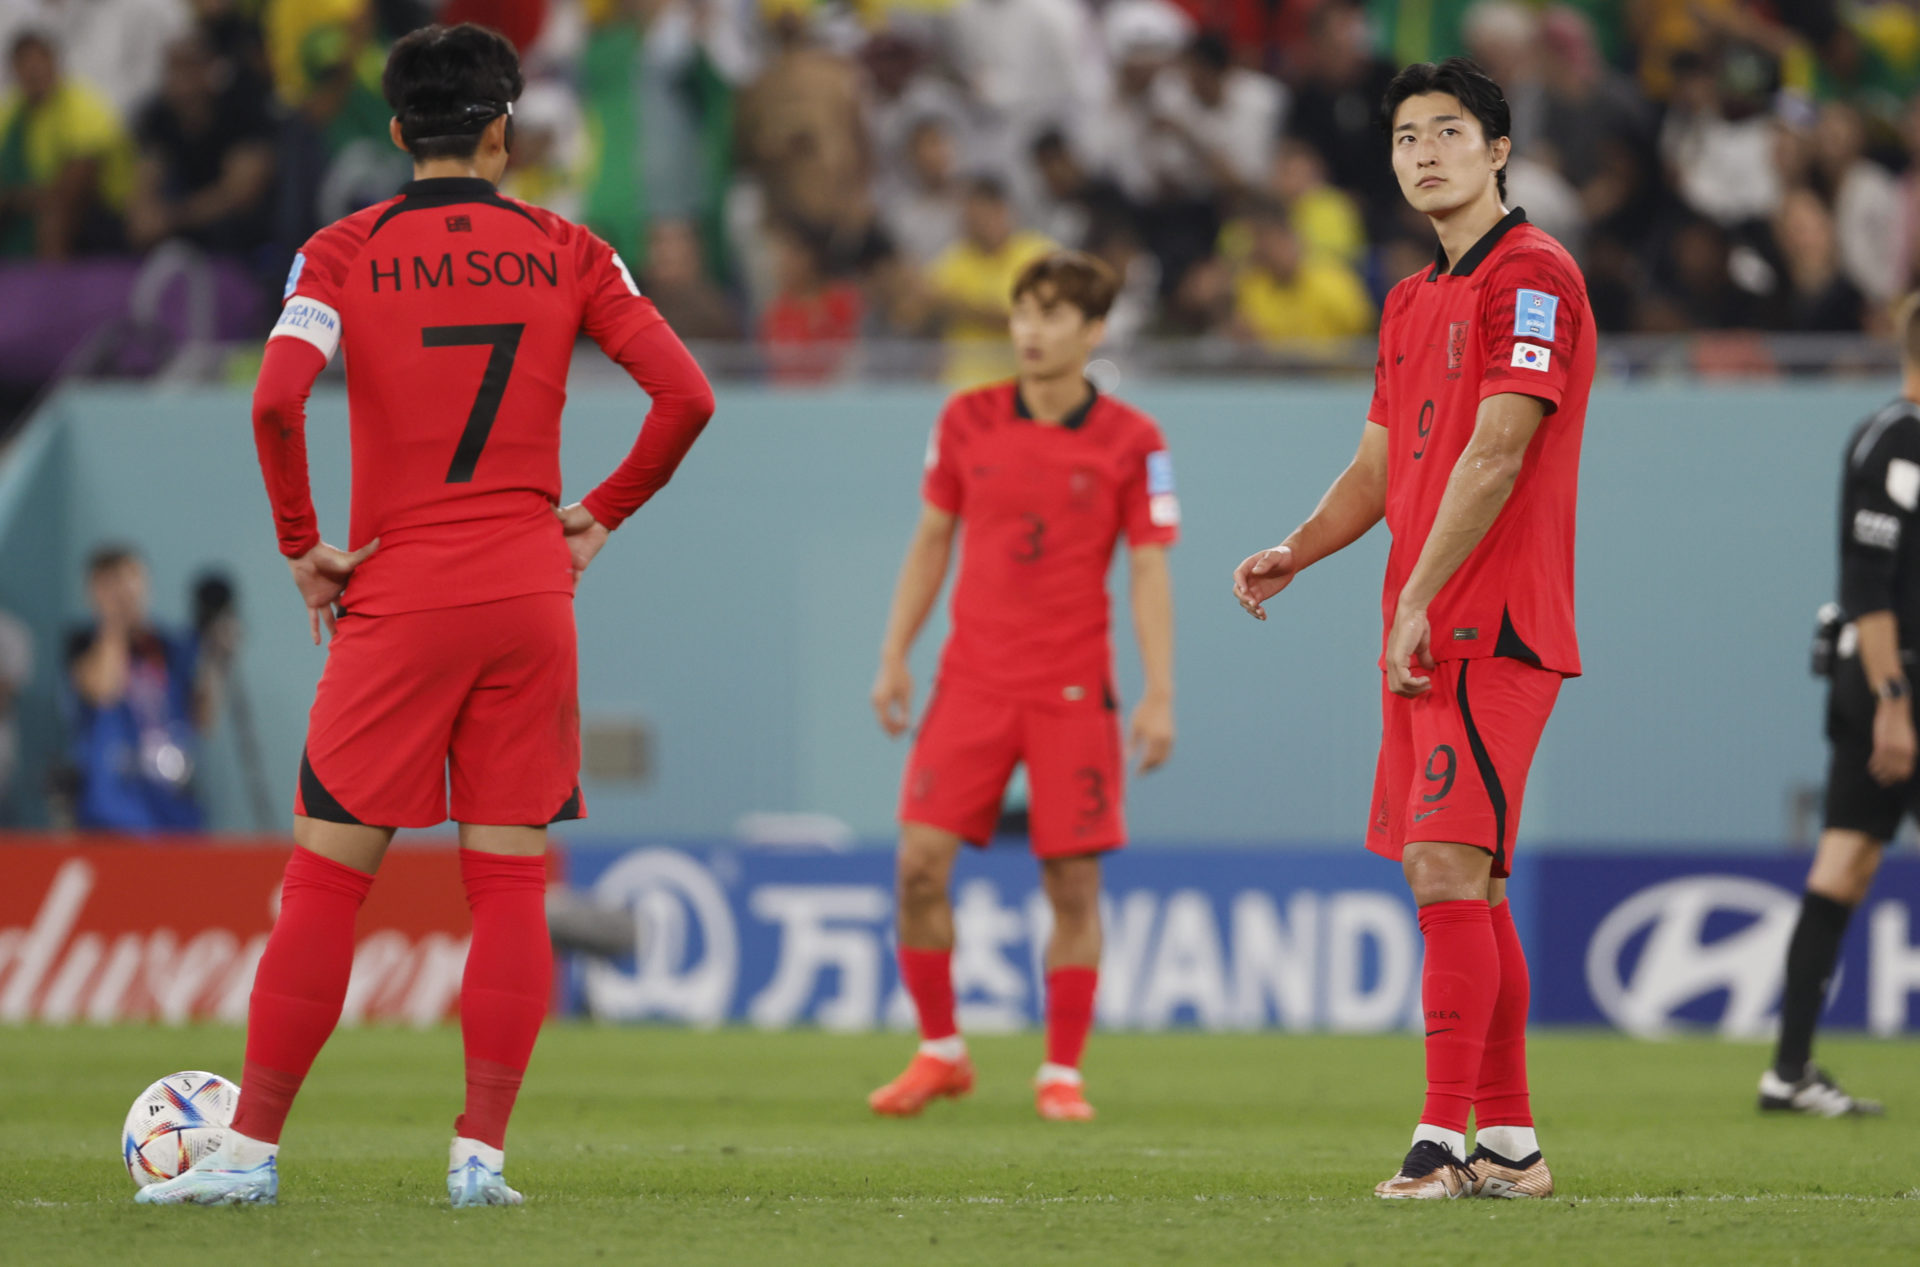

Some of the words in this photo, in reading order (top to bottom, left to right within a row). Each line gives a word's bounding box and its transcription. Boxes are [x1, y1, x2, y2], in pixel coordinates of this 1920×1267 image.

[466, 250, 558, 287] SON
[421, 322, 526, 484] 7
[1412, 399, 1435, 460] 9
[1011, 511, 1046, 564] 3
[1073, 766, 1109, 820] 3
[1422, 744, 1457, 803] 9
